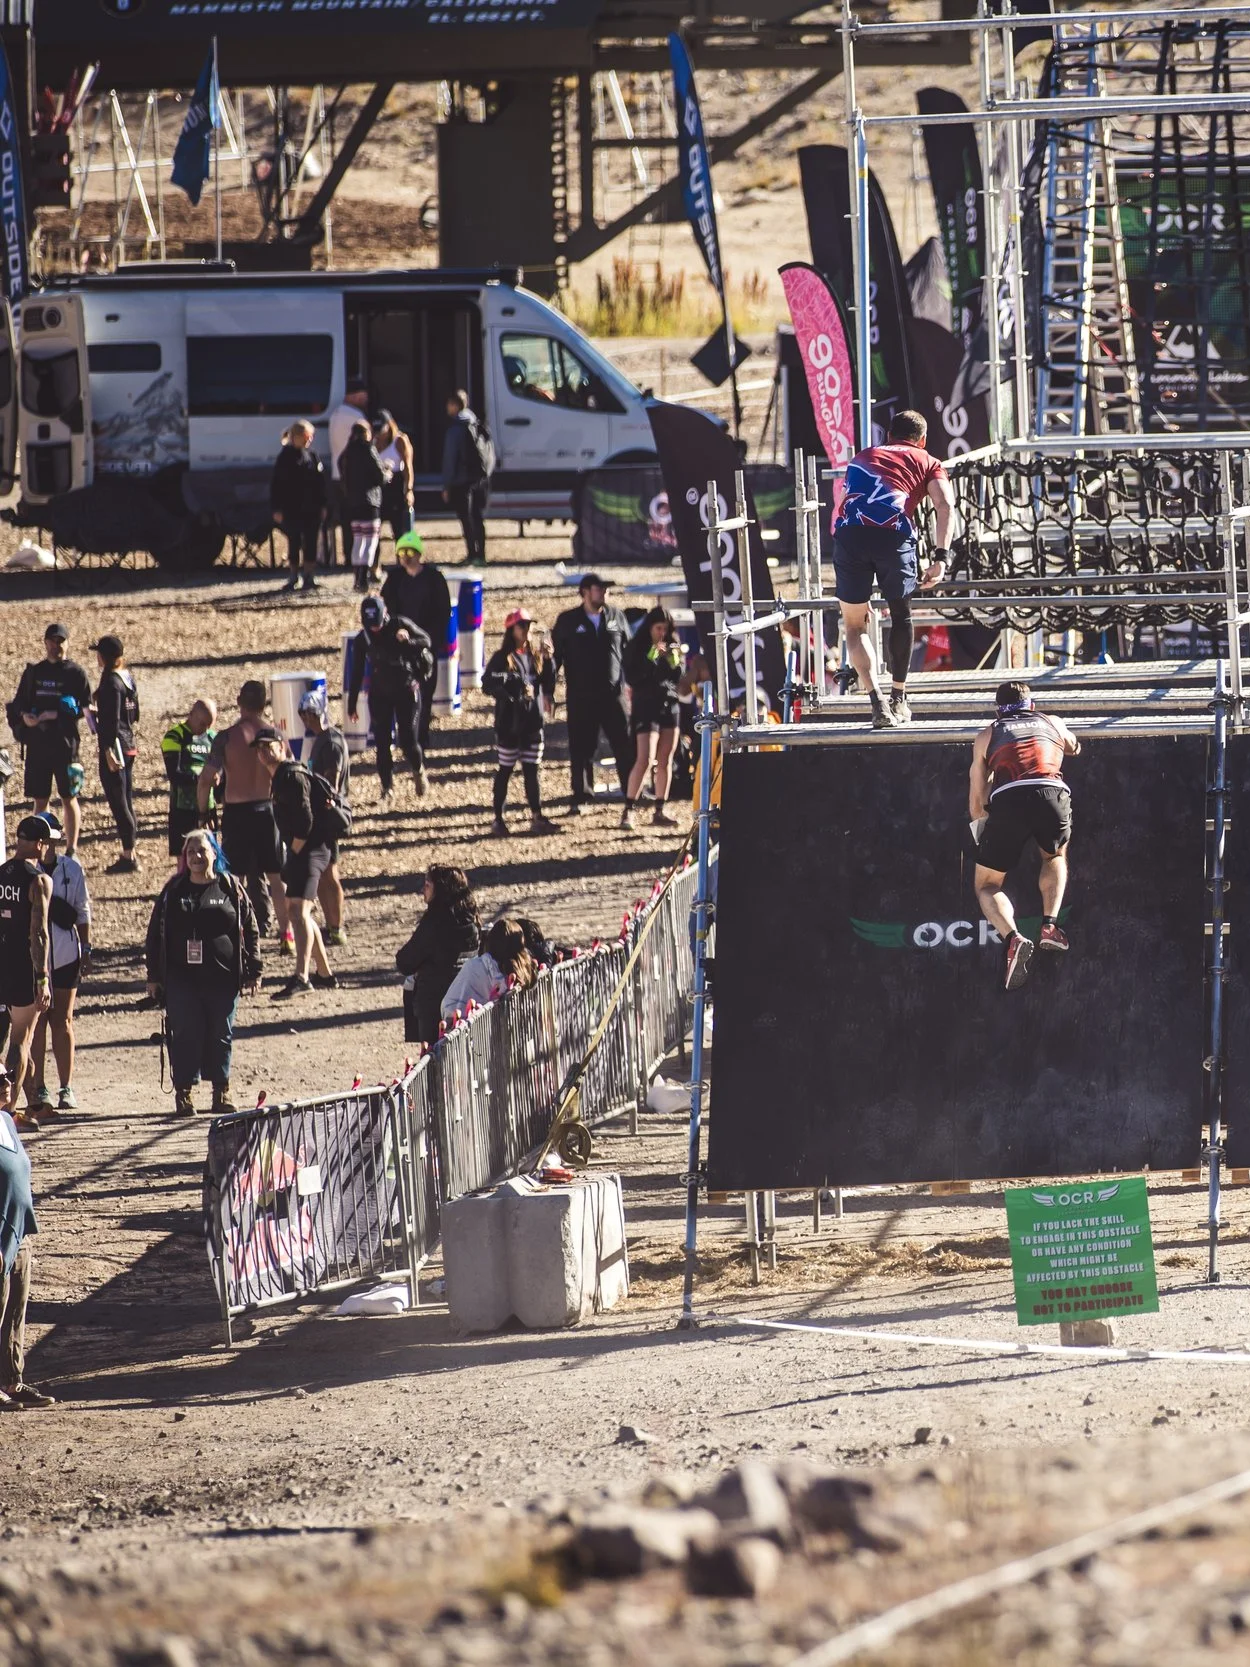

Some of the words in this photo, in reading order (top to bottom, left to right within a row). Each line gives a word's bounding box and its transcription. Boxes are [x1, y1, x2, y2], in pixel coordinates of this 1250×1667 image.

[169, 1, 284, 15] MAMMOTH
[2, 151, 23, 297] OUTSIDE
[913, 919, 1003, 948] OCR
[1058, 1191, 1094, 1206] OCR
[1033, 1222, 1041, 1232] IF
[1043, 1221, 1060, 1231] YOU
[1061, 1218, 1083, 1230] LACK
[1084, 1217, 1100, 1228] THE
[1101, 1214, 1125, 1225] SKILL
[1020, 1236, 1031, 1246] TO
[1032, 1233, 1065, 1244] ENGAGE
[1066, 1232, 1076, 1242] IN
[1077, 1230, 1097, 1241] THIS
[1098, 1225, 1141, 1239] OBSTACLE
[1031, 1248, 1044, 1258] OR
[1045, 1245, 1067, 1256] HAVE
[1068, 1244, 1084, 1255] ANY
[1086, 1239, 1132, 1252] CONDITION
[1050, 1256, 1078, 1269] WHICH
[1079, 1254, 1105, 1266] MIGHT
[1107, 1253, 1118, 1263] BE
[1026, 1270, 1067, 1283] AFFECTED
[1068, 1269, 1079, 1280] BY
[1080, 1267, 1100, 1278] THIS
[1102, 1263, 1144, 1276] OBSTACLE
[1040, 1287, 1063, 1300] YOU
[1065, 1285, 1088, 1298] MAY
[1090, 1281, 1134, 1296] CHOOSE
[1033, 1303, 1055, 1316] NOT
[1057, 1302, 1072, 1314] TO
[1073, 1294, 1144, 1312] PARTICIPATE
